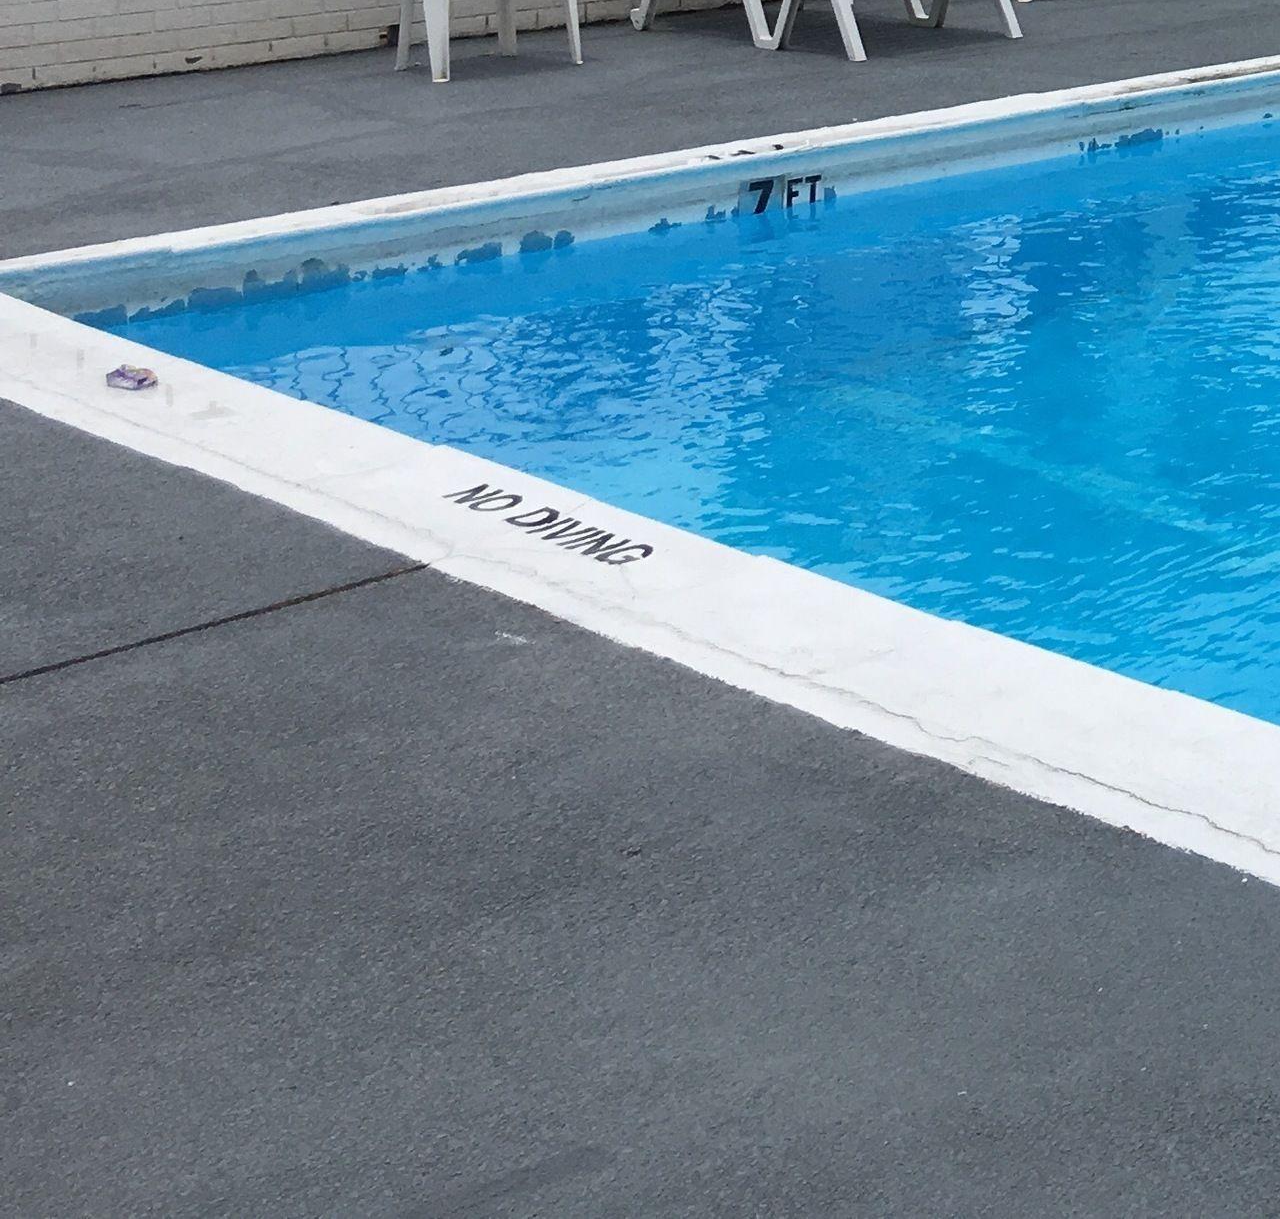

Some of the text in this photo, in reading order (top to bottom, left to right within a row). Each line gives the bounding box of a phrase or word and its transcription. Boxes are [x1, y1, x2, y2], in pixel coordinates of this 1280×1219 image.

[748, 173, 822, 214] 7 FT
[441, 483, 655, 565] NO DIVING
